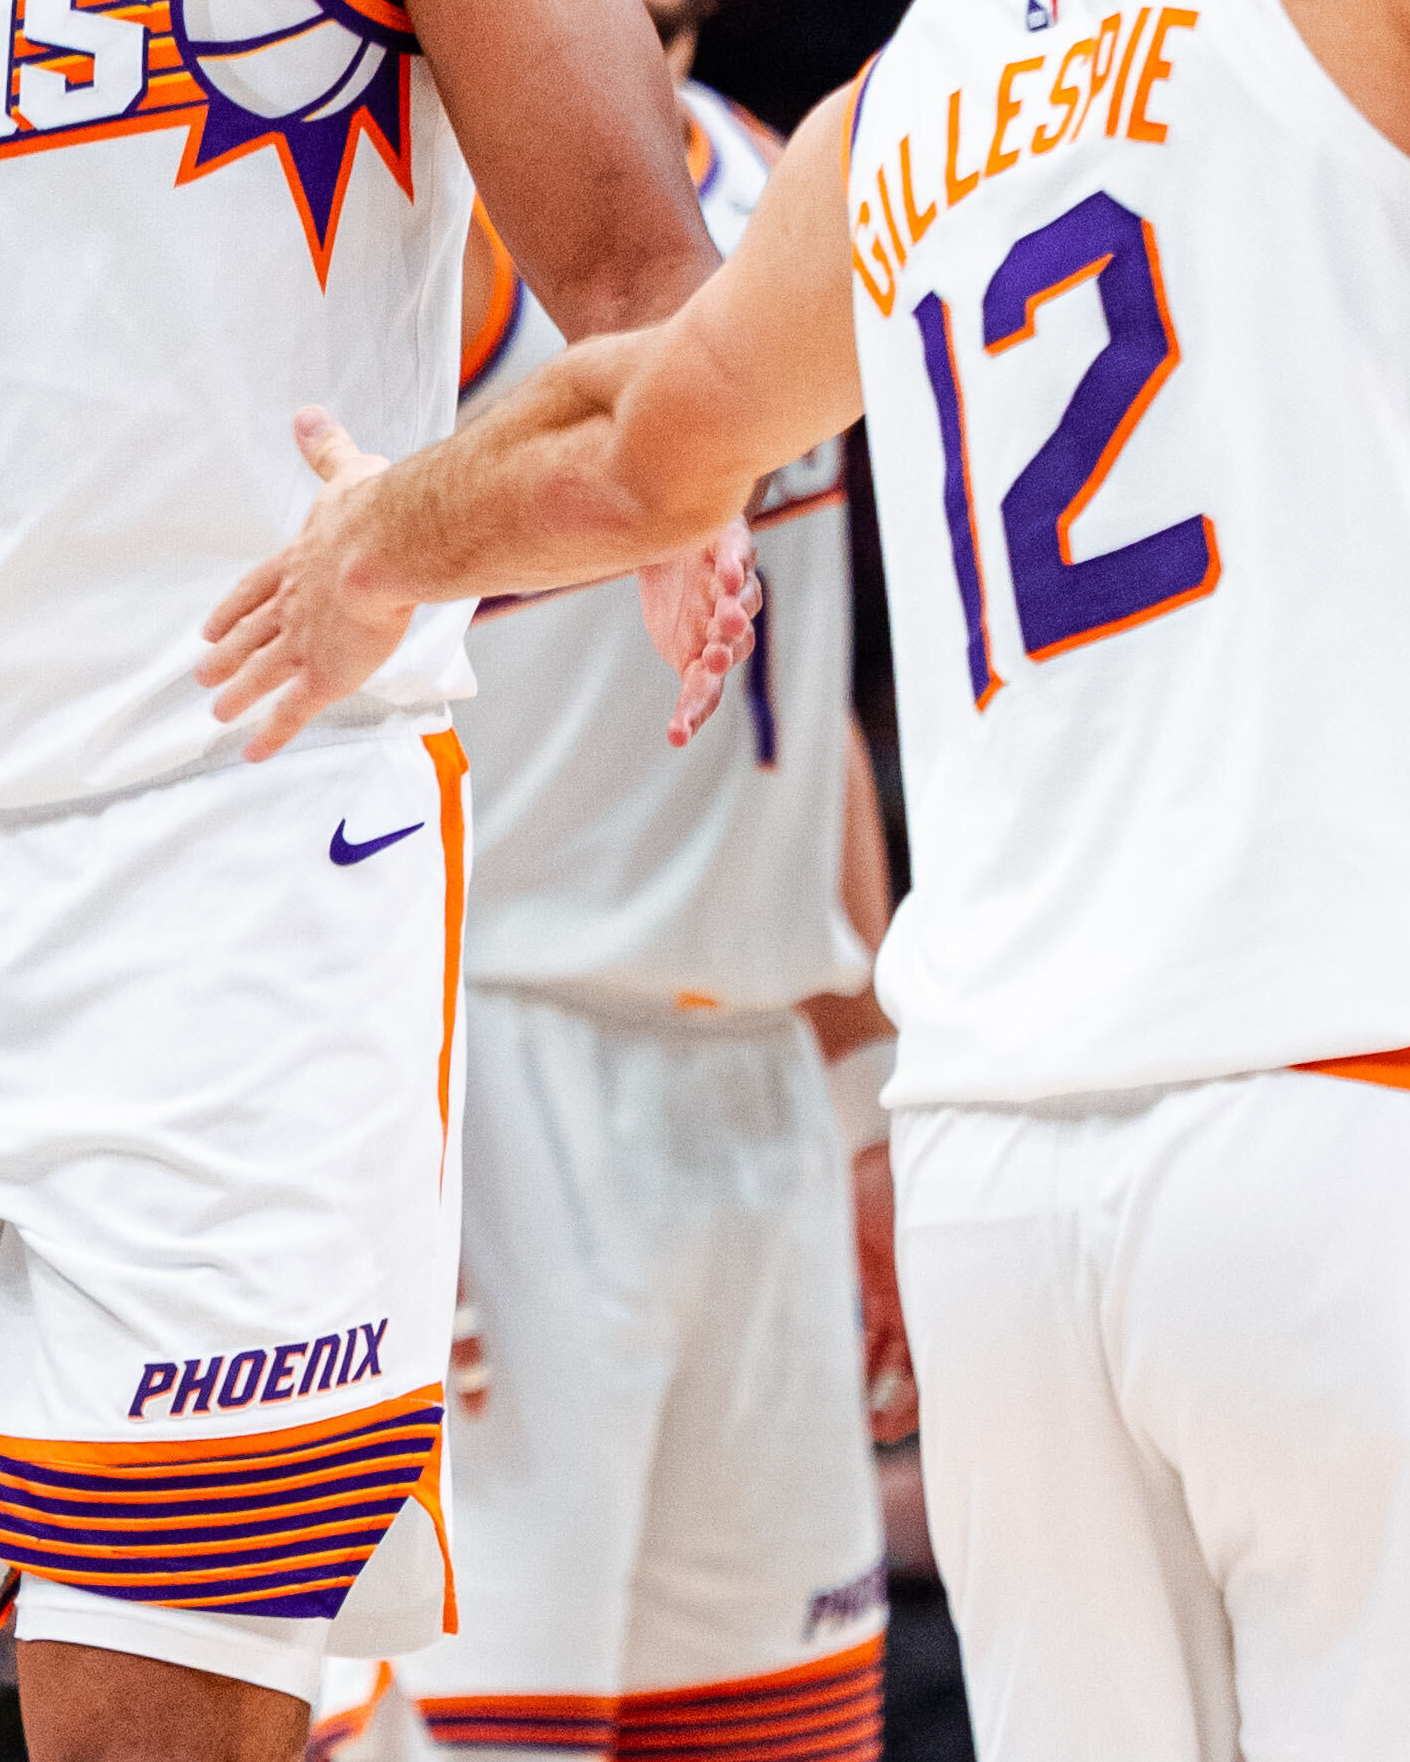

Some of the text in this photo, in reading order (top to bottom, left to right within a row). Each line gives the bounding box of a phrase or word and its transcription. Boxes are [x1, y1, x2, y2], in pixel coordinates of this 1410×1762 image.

[853, 6, 1200, 318] GILLESPIE
[913, 189, 1222, 713] 12
[127, 1317, 389, 1421] PHOENIX
